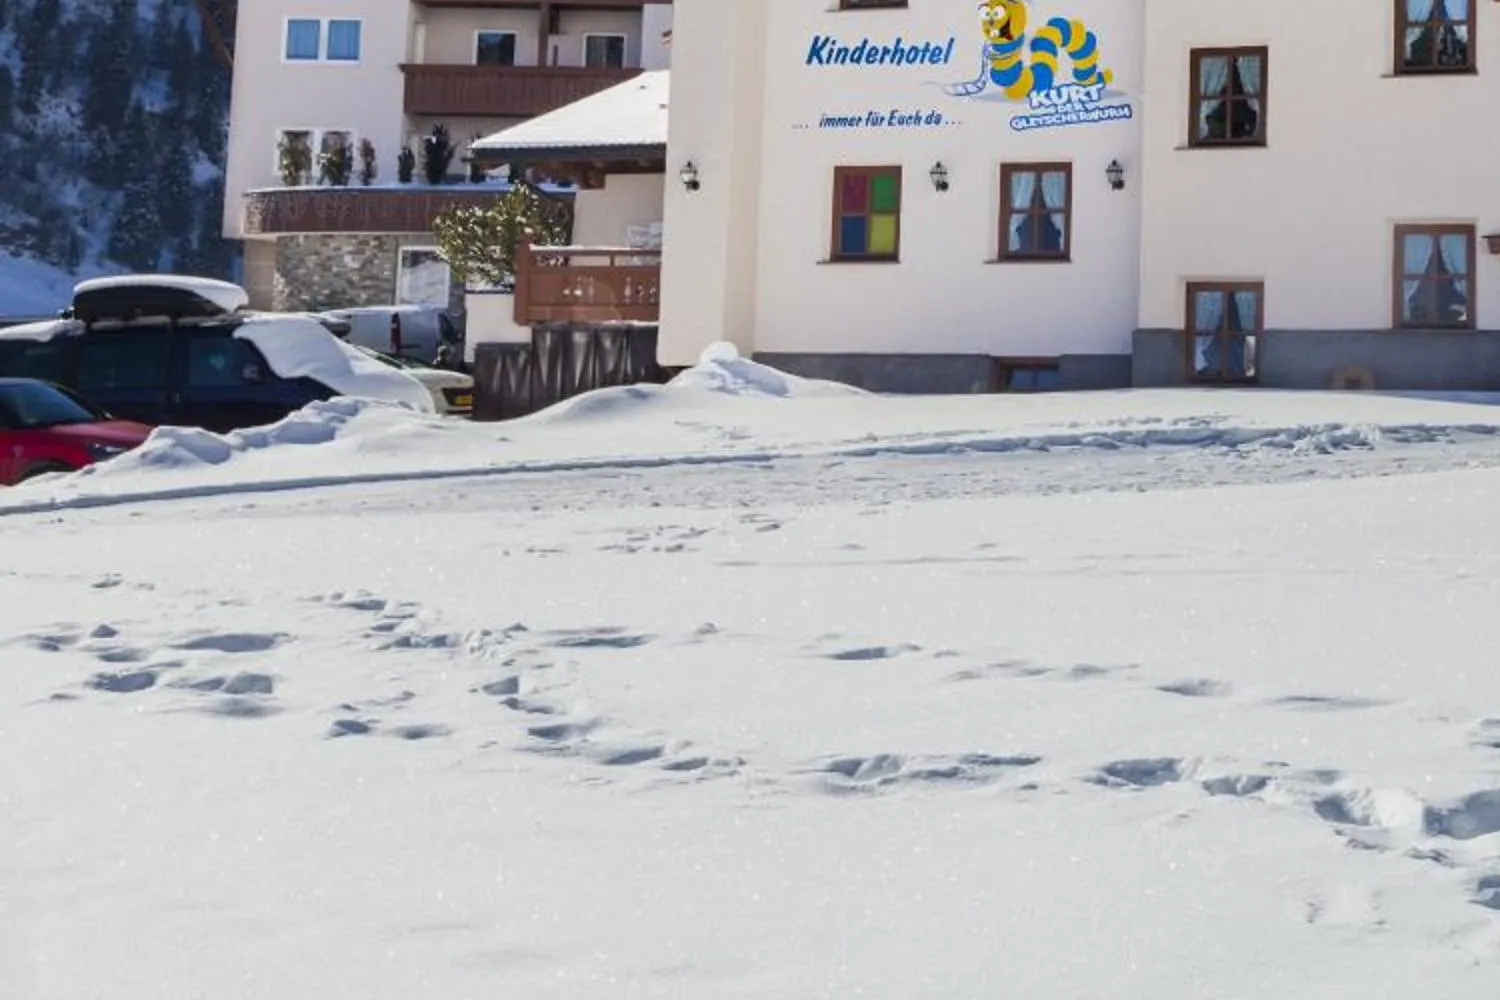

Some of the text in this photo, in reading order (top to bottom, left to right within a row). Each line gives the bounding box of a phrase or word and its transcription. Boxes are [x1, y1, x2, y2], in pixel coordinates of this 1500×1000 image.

[806, 36, 956, 66] Kinderhotel
[1029, 83, 1105, 108] KURT
[819, 113, 862, 128] immer
[864, 110, 886, 127] für
[887, 109, 923, 127] Euch
[924, 109, 943, 126] da
